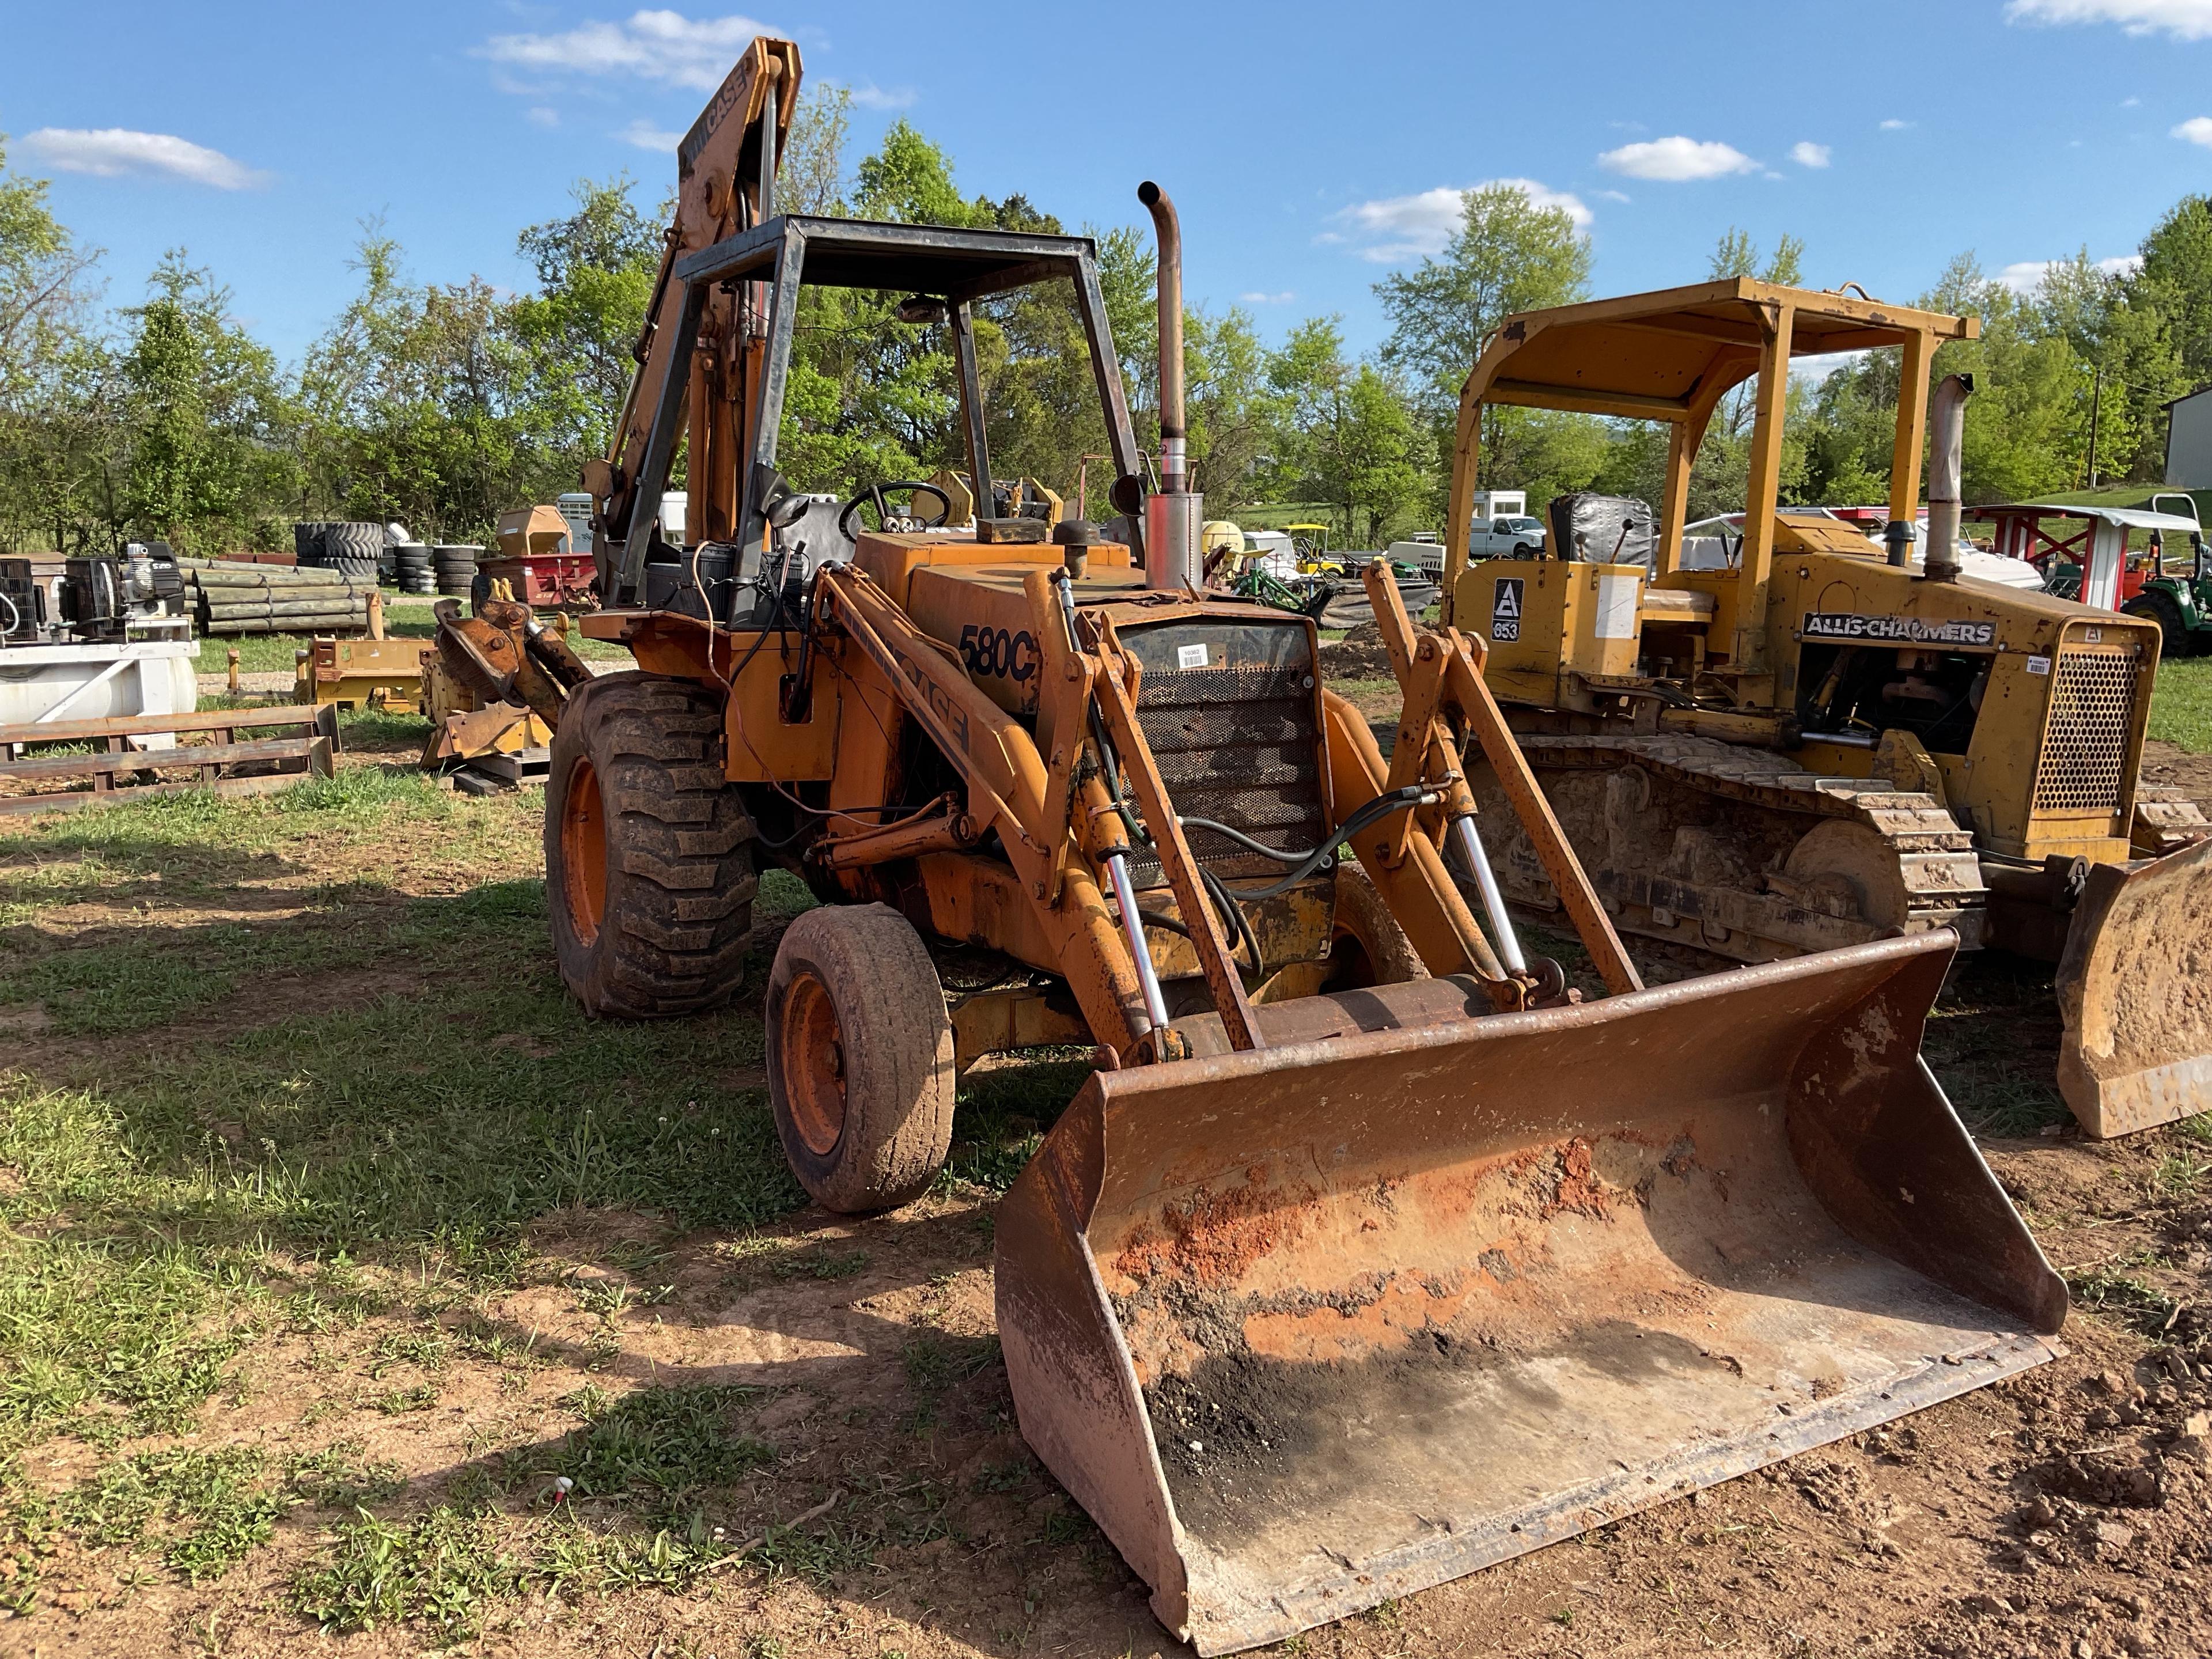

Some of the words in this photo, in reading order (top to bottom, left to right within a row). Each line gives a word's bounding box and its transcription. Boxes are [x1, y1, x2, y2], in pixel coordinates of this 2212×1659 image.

[707, 66, 745, 134] CASE
[959, 624, 1036, 681] 580C
[899, 656, 968, 750] CASE
